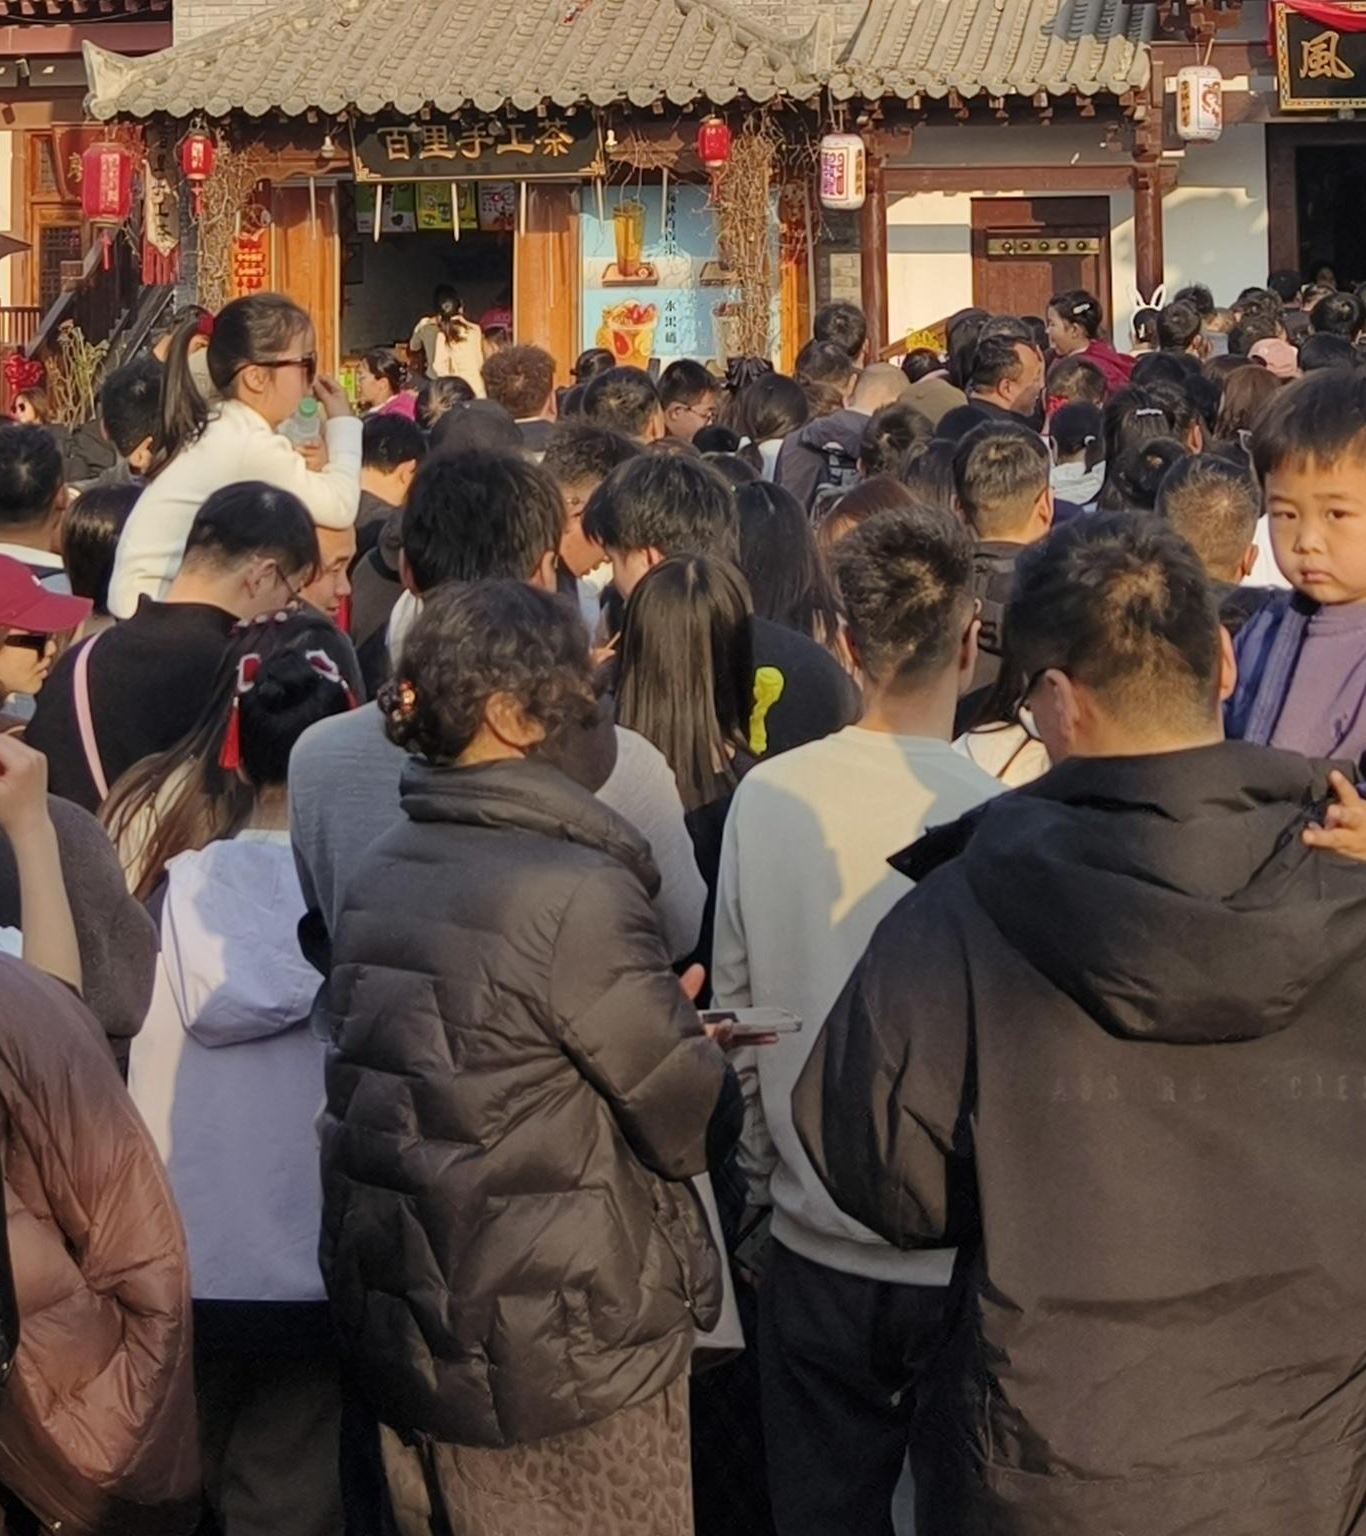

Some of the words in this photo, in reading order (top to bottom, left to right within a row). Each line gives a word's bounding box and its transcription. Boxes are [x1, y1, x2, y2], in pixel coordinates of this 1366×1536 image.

[377, 117, 574, 160] 百里手工茶
